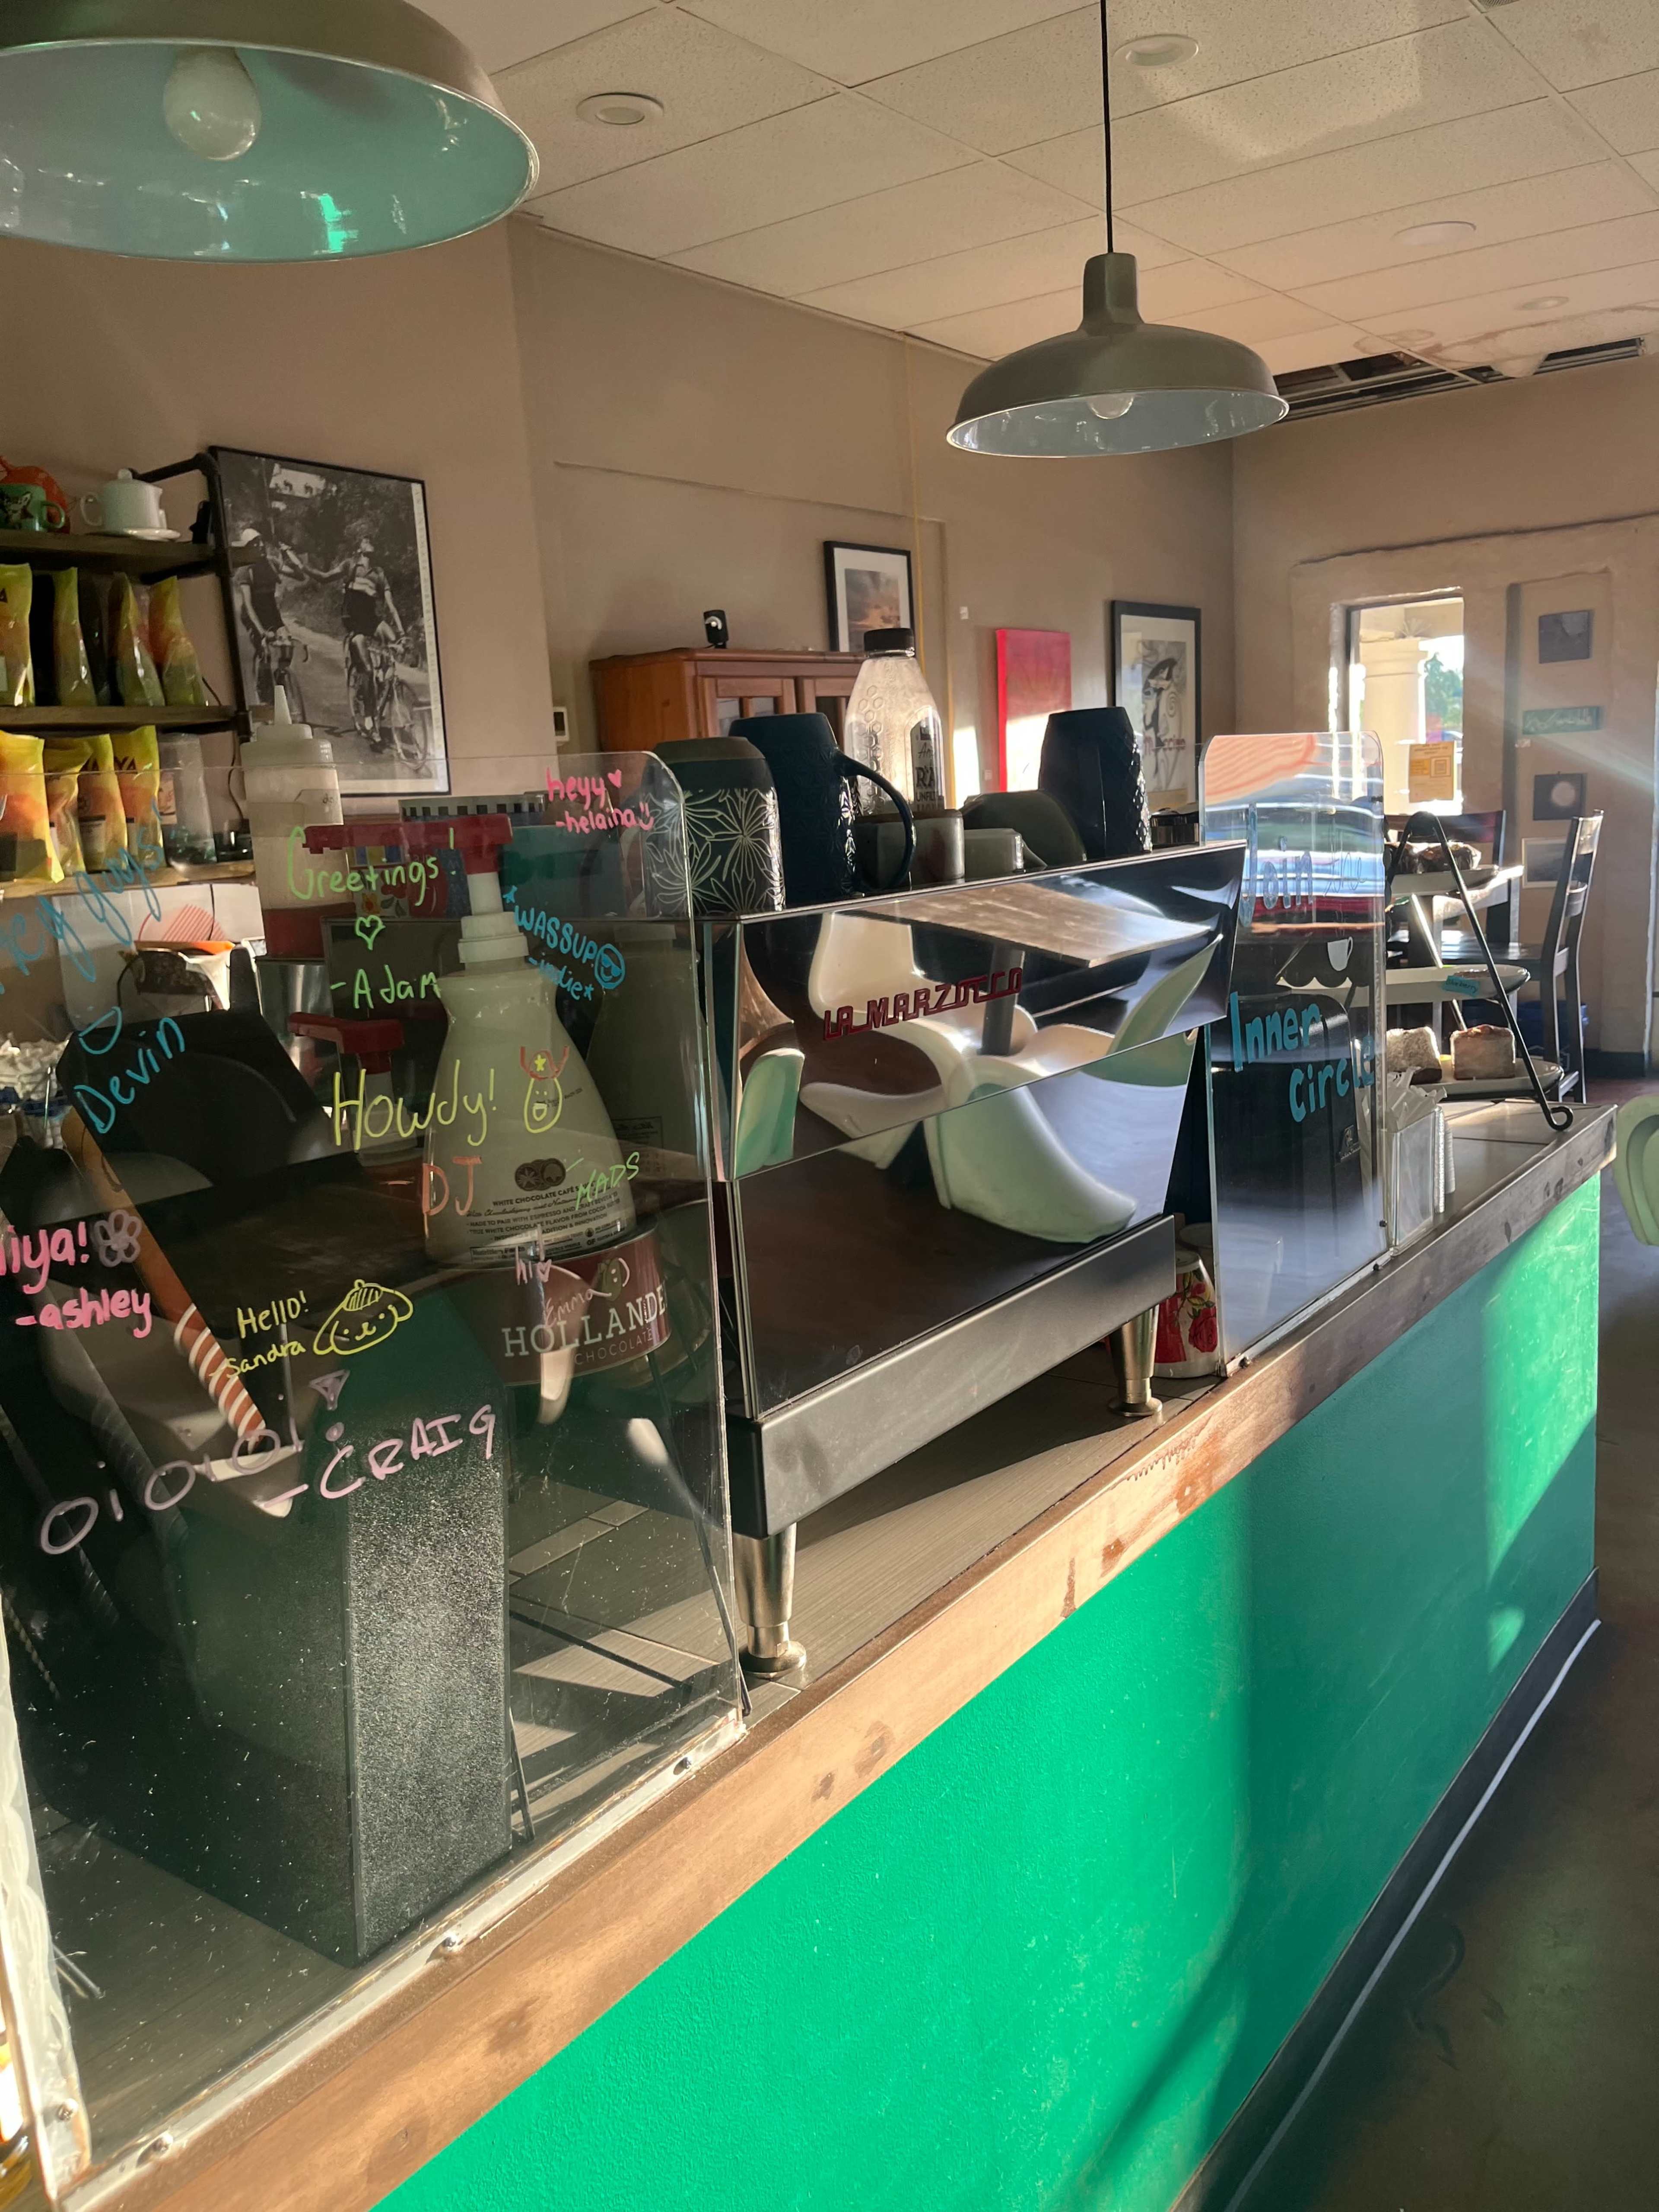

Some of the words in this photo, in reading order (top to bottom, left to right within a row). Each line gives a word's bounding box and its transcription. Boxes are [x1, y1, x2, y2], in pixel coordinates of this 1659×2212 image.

[546, 767, 607, 810] heyy
[286, 827, 456, 906] Greetings!
[1238, 803, 1314, 928] Join
[513, 905, 598, 964] WASSUP
[823, 1005, 857, 1041] LA
[867, 966, 1023, 1029] MARZOCCO
[1230, 991, 1322, 1073] Inner
[73, 1017, 186, 1134] Devin
[333, 1059, 497, 1150] Howdy!
[493, 1198, 514, 1207] WHITE
[515, 1191, 556, 1204] CHOCOLATE
[558, 1186, 575, 1196] CAFÉ
[505, 1222, 544, 1232] CHOCOLATE
[546, 1216, 570, 1226] FLAVOR
[571, 1211, 588, 1219] FROM
[589, 1205, 606, 1214] COCOA
[530, 1210, 561, 1220] ESPRESSO
[542, 1224, 568, 1234] ADITION
[15, 1286, 153, 1339] -ashley
[237, 1290, 309, 1339] Hello!
[501, 1285, 667, 1358] HOLLANDE
[574, 1328, 655, 1365] CHOCOLATE
